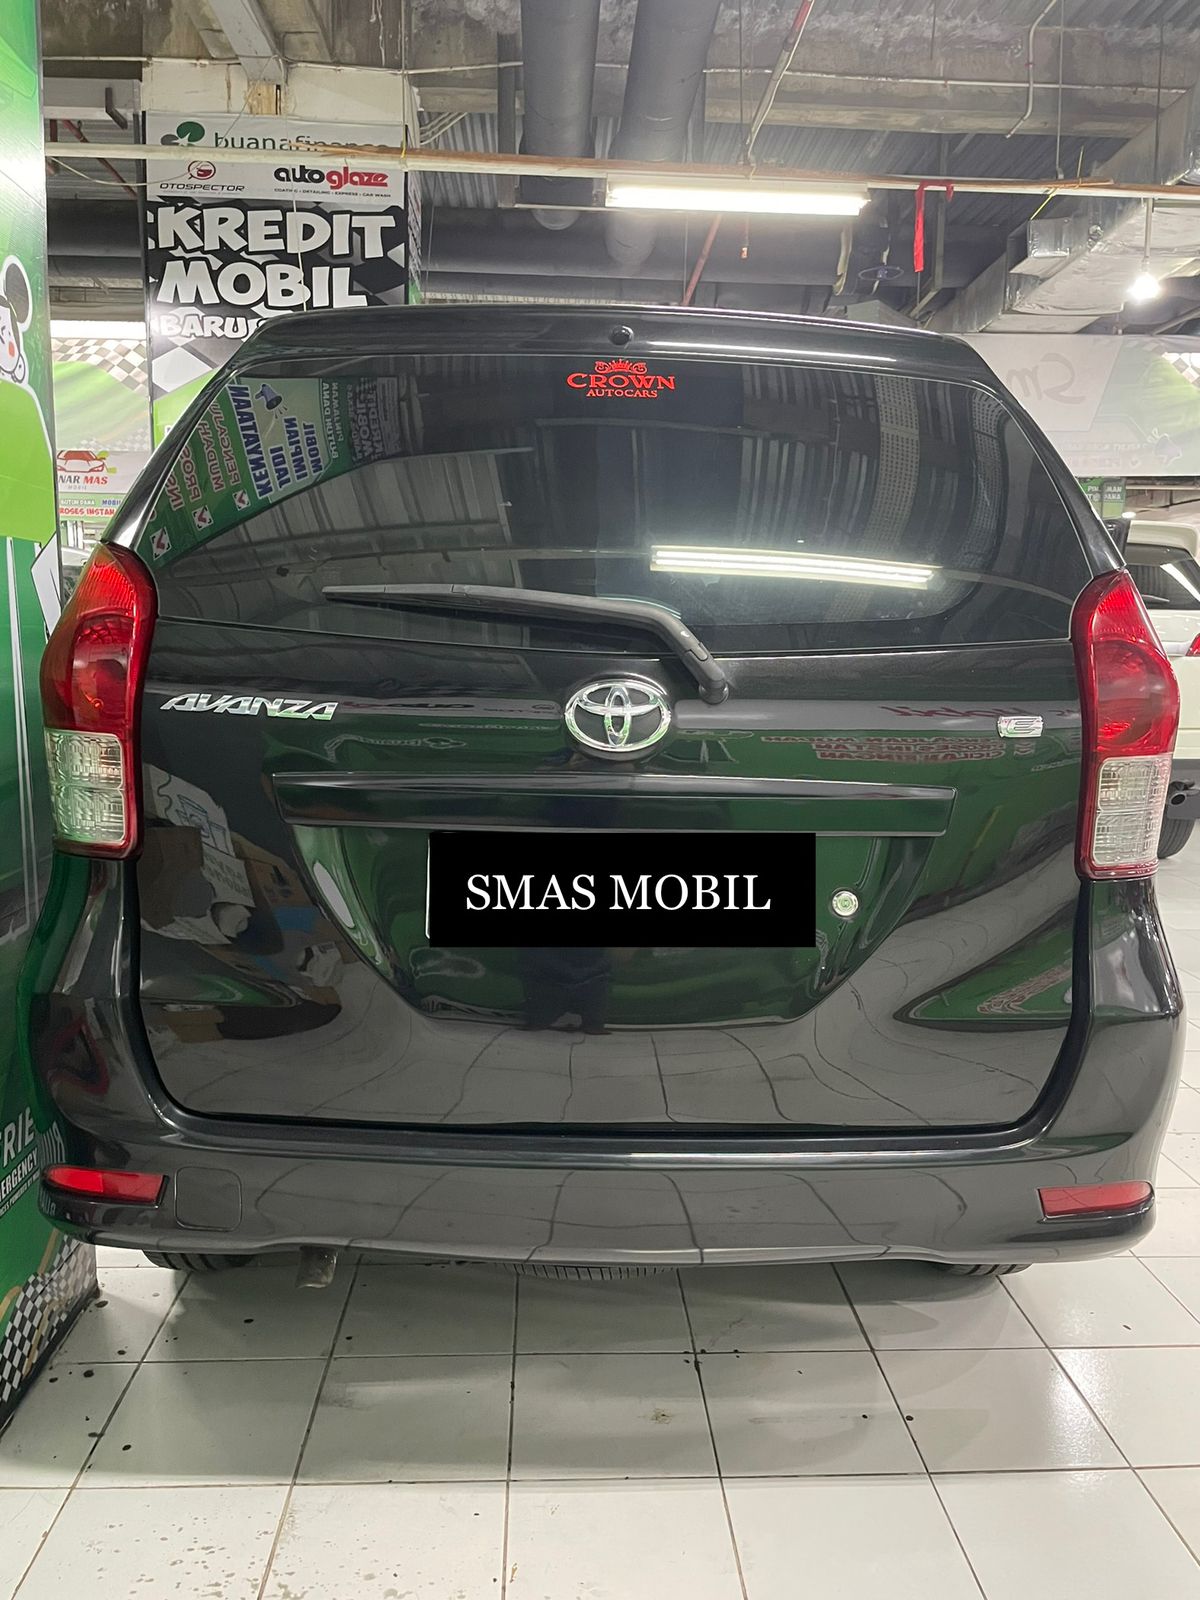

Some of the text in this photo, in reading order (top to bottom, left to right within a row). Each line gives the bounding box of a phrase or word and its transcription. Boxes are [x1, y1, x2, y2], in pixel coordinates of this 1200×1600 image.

[159, 182, 245, 192] OTOSPECTOR
[274, 165, 389, 190] autoglaze
[157, 206, 396, 259] KREDIT
[156, 259, 368, 309] MOBIL
[158, 314, 249, 339] BARU
[566, 372, 676, 390] CROWN
[586, 388, 658, 398] AUTOCARS
[83, 475, 108, 485] MAS
[160, 693, 338, 721] AVANZA
[0, 1106, 35, 1168] RIE
[0, 1147, 38, 1203] ERGENCY
